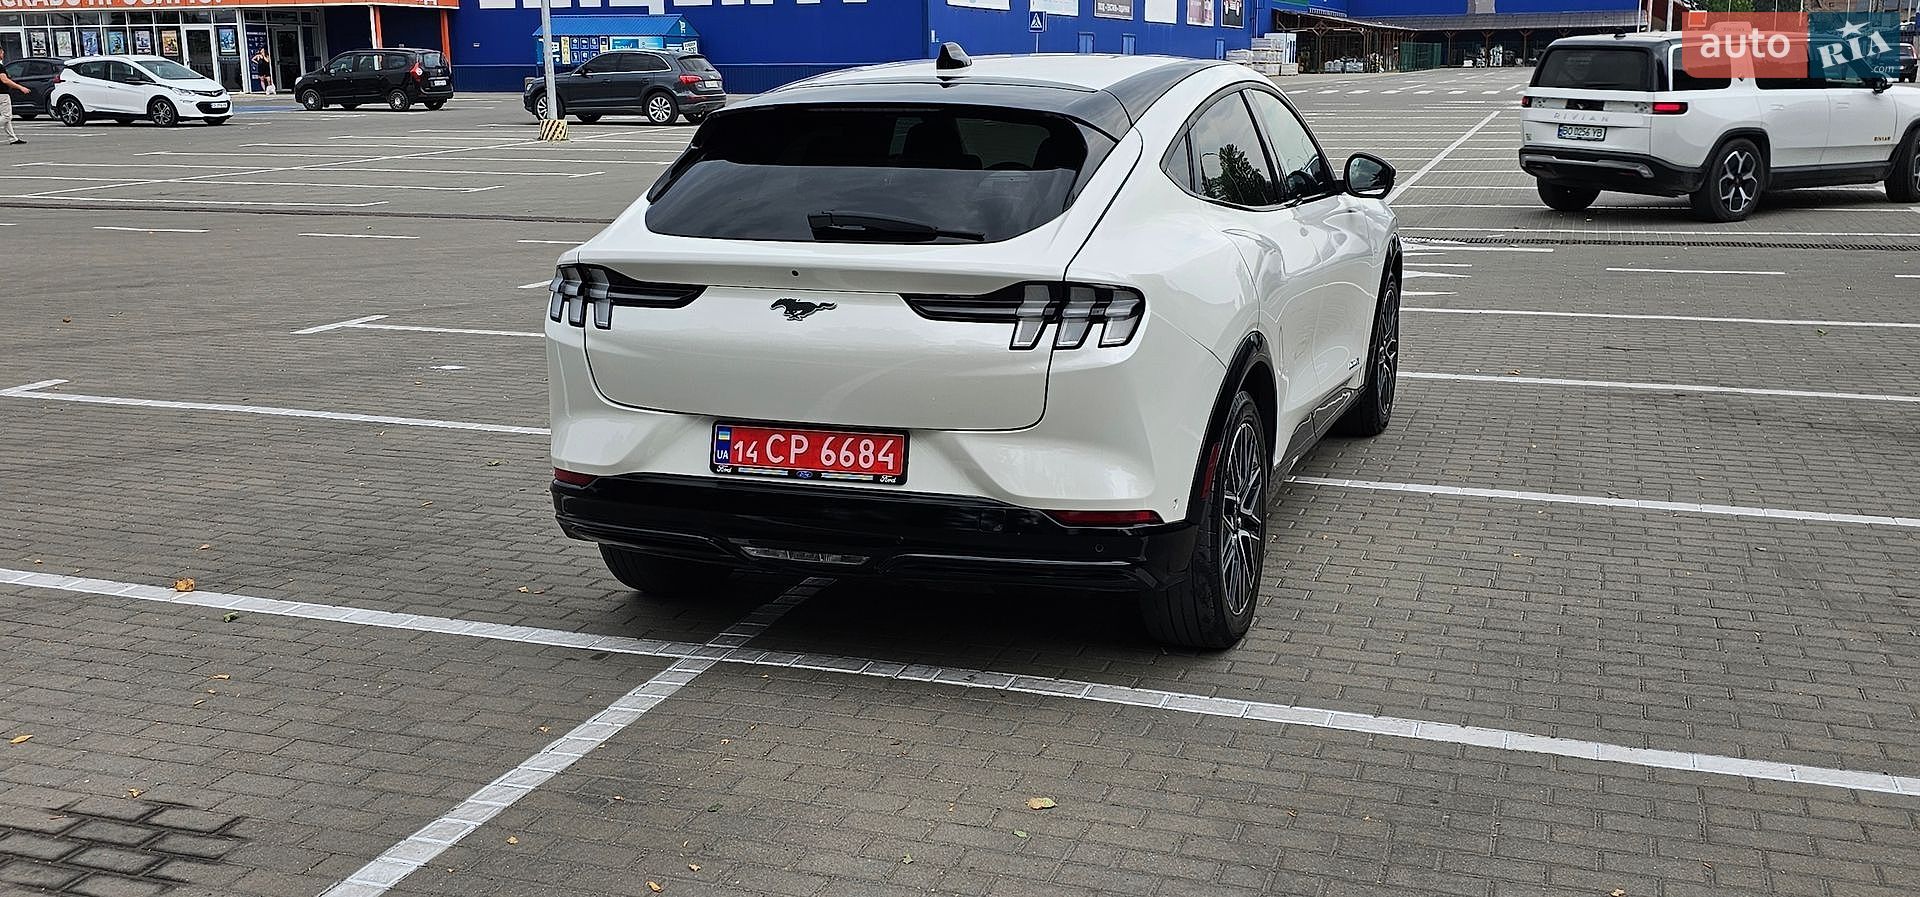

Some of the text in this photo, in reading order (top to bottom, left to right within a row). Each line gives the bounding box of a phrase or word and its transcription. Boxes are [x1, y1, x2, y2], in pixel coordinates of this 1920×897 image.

[716, 449, 729, 461] UA
[733, 433, 894, 470] 14 CP 6684
[716, 464, 732, 474] Ford
[879, 474, 897, 484] Ford
